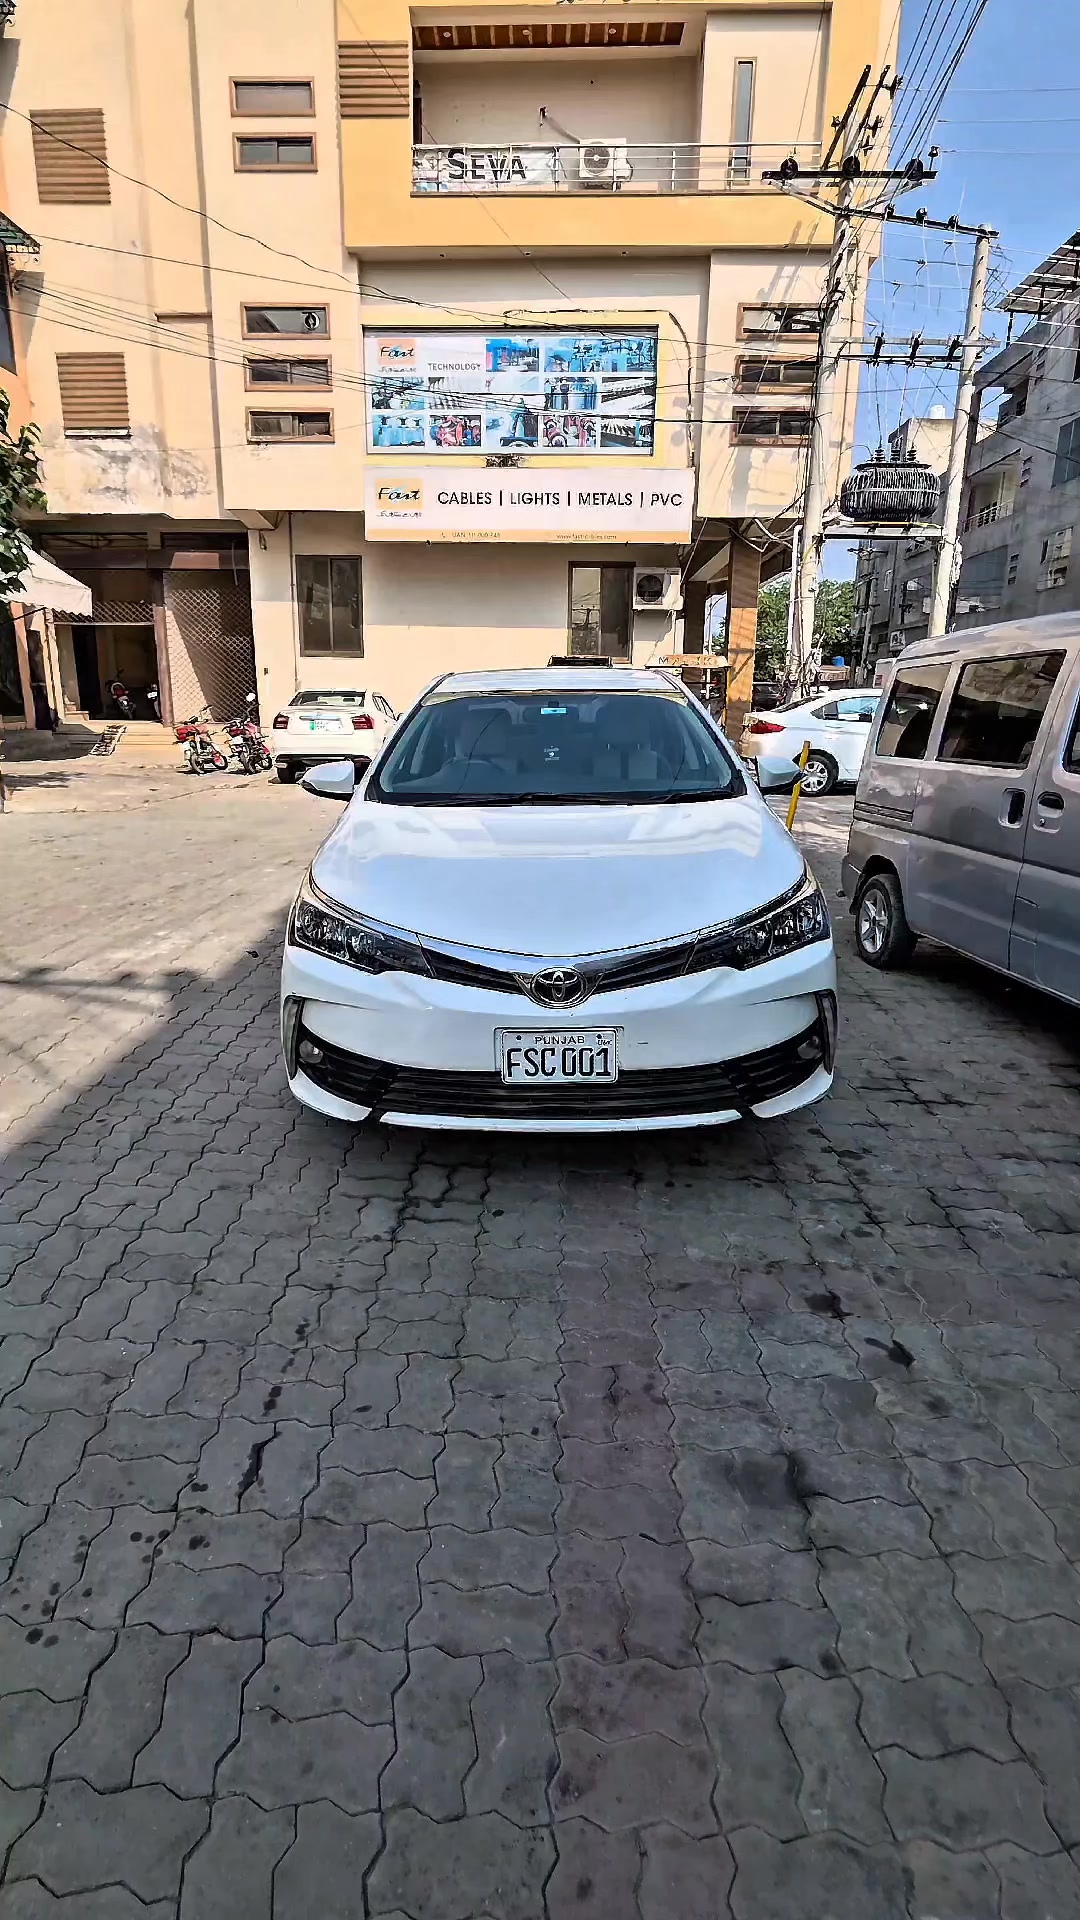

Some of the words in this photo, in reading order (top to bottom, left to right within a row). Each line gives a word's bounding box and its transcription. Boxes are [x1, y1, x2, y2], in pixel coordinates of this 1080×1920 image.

[447, 148, 527, 180] SEVA
[380, 346, 415, 359] Fast
[427, 362, 481, 371] TECHNOLOGY
[377, 487, 421, 501] Fast
[437, 491, 493, 505] CABLES
[510, 492, 560, 505] LIGHTS
[578, 492, 633, 506] METALS
[650, 493, 683, 507] PVC
[535, 1035, 585, 1045] PUNJAB
